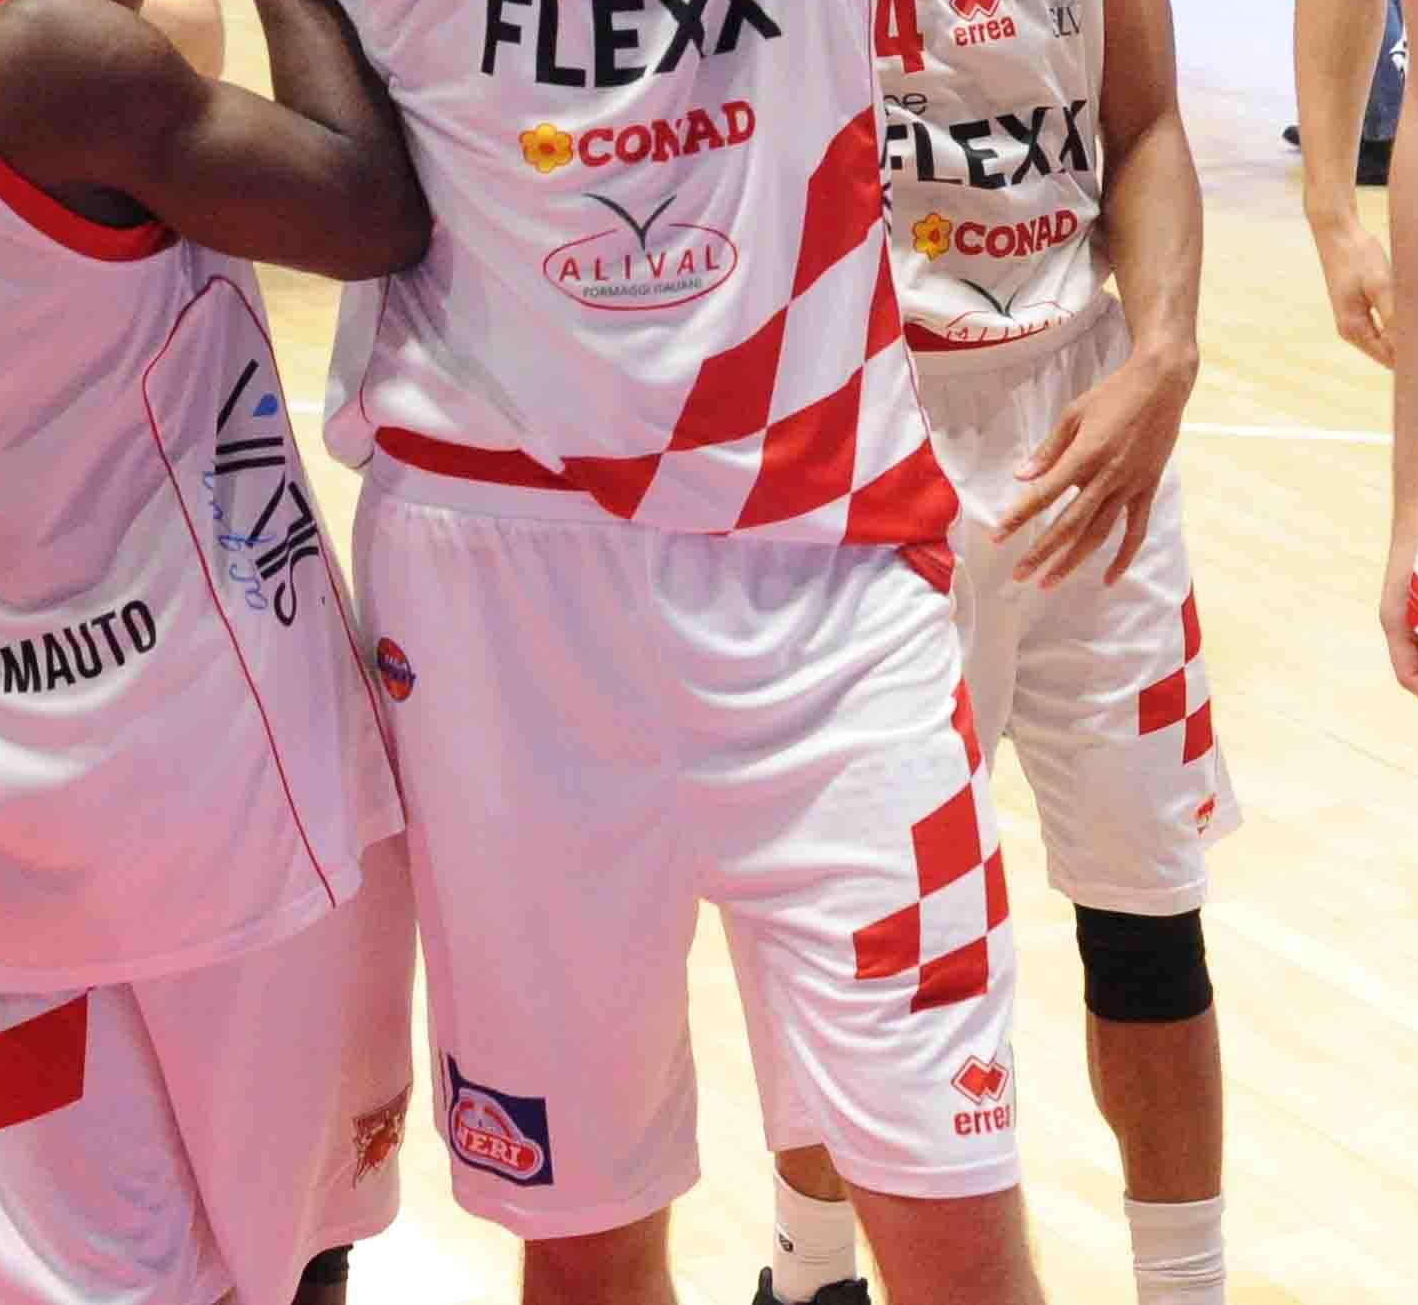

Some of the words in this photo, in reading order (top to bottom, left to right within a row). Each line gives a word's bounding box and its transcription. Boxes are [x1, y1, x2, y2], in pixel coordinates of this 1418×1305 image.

[952, 16, 1018, 47] errea
[577, 100, 757, 168] CONAD
[954, 209, 1078, 258] CONAD
[558, 244, 720, 283] ALIVAL
